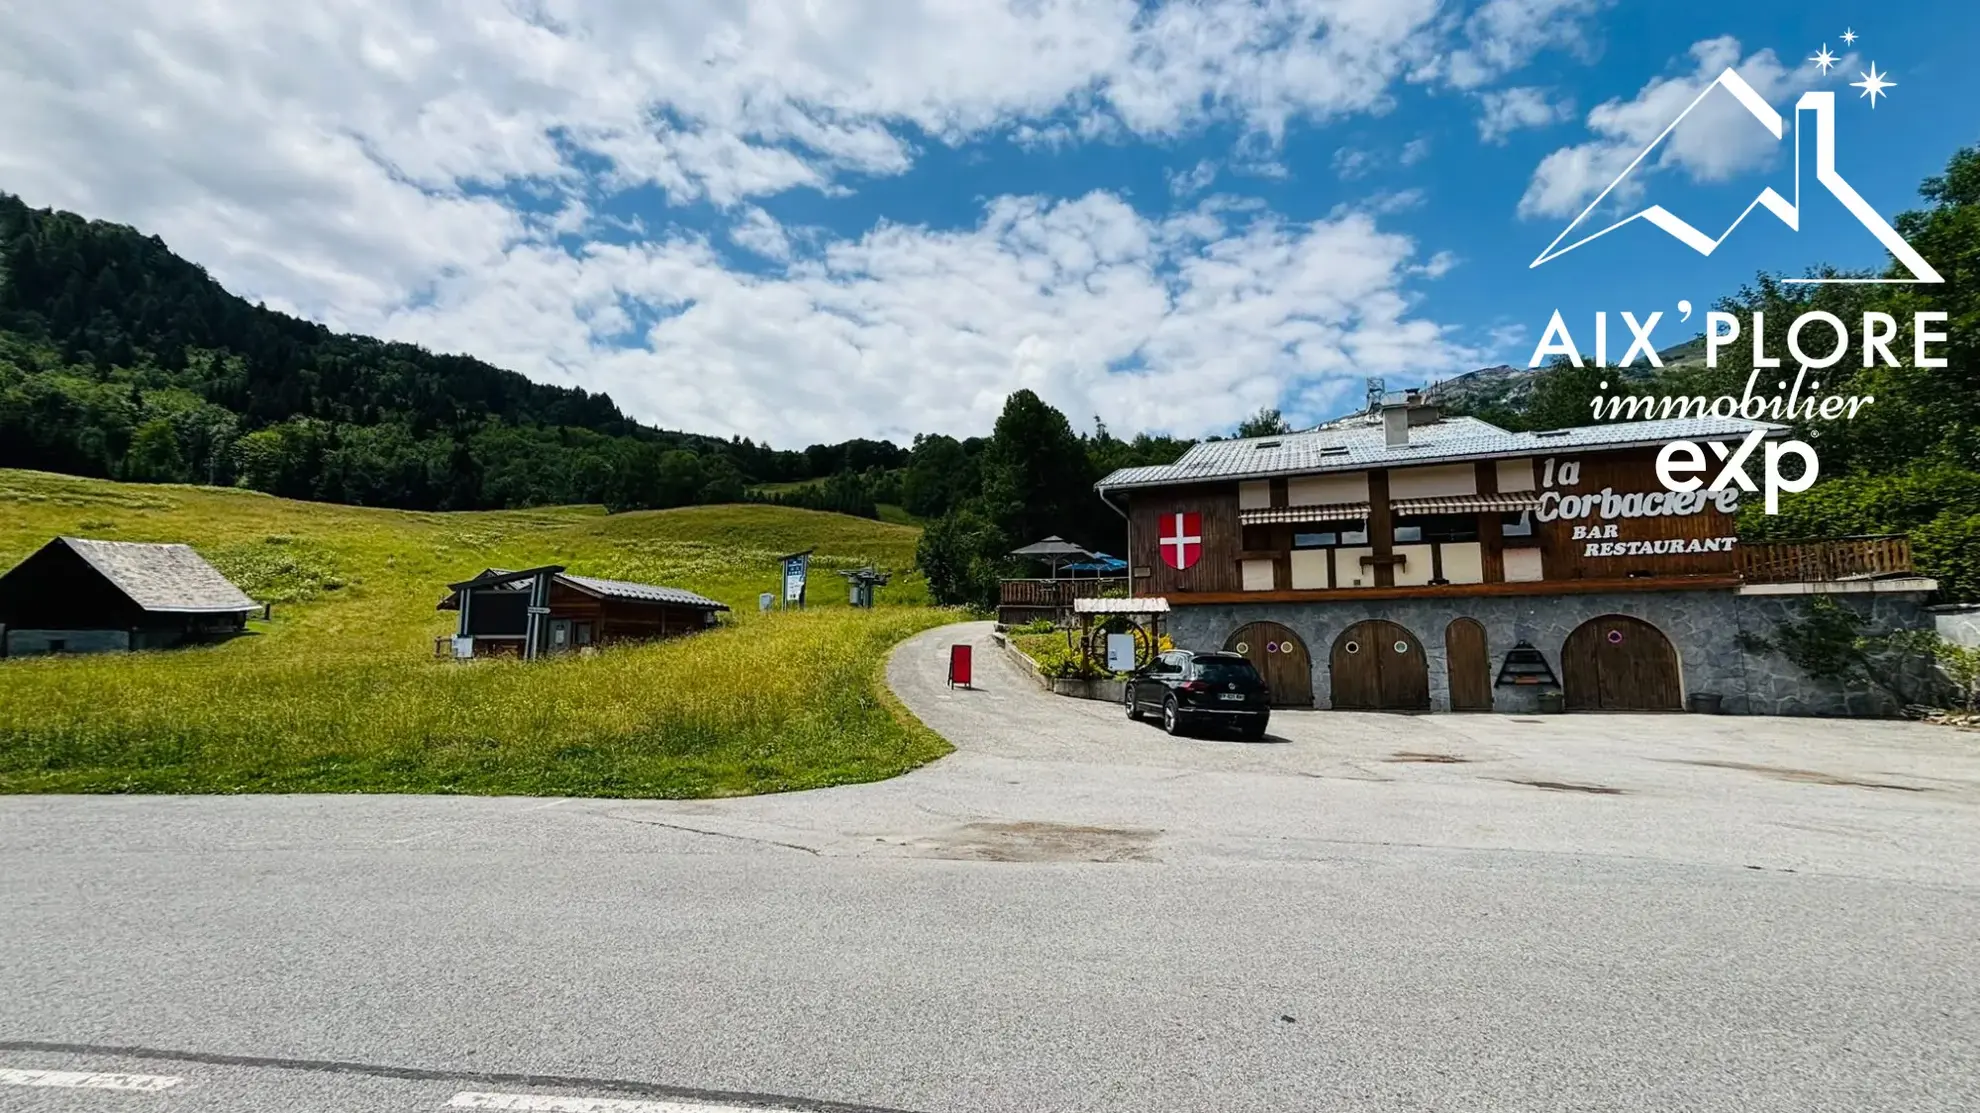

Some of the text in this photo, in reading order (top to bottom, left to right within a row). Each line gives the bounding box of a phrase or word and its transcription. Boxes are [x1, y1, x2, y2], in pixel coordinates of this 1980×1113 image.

[1542, 457, 1581, 488] la
[1571, 524, 1619, 540] BAR
[1583, 537, 1738, 557] RESTAURANT
